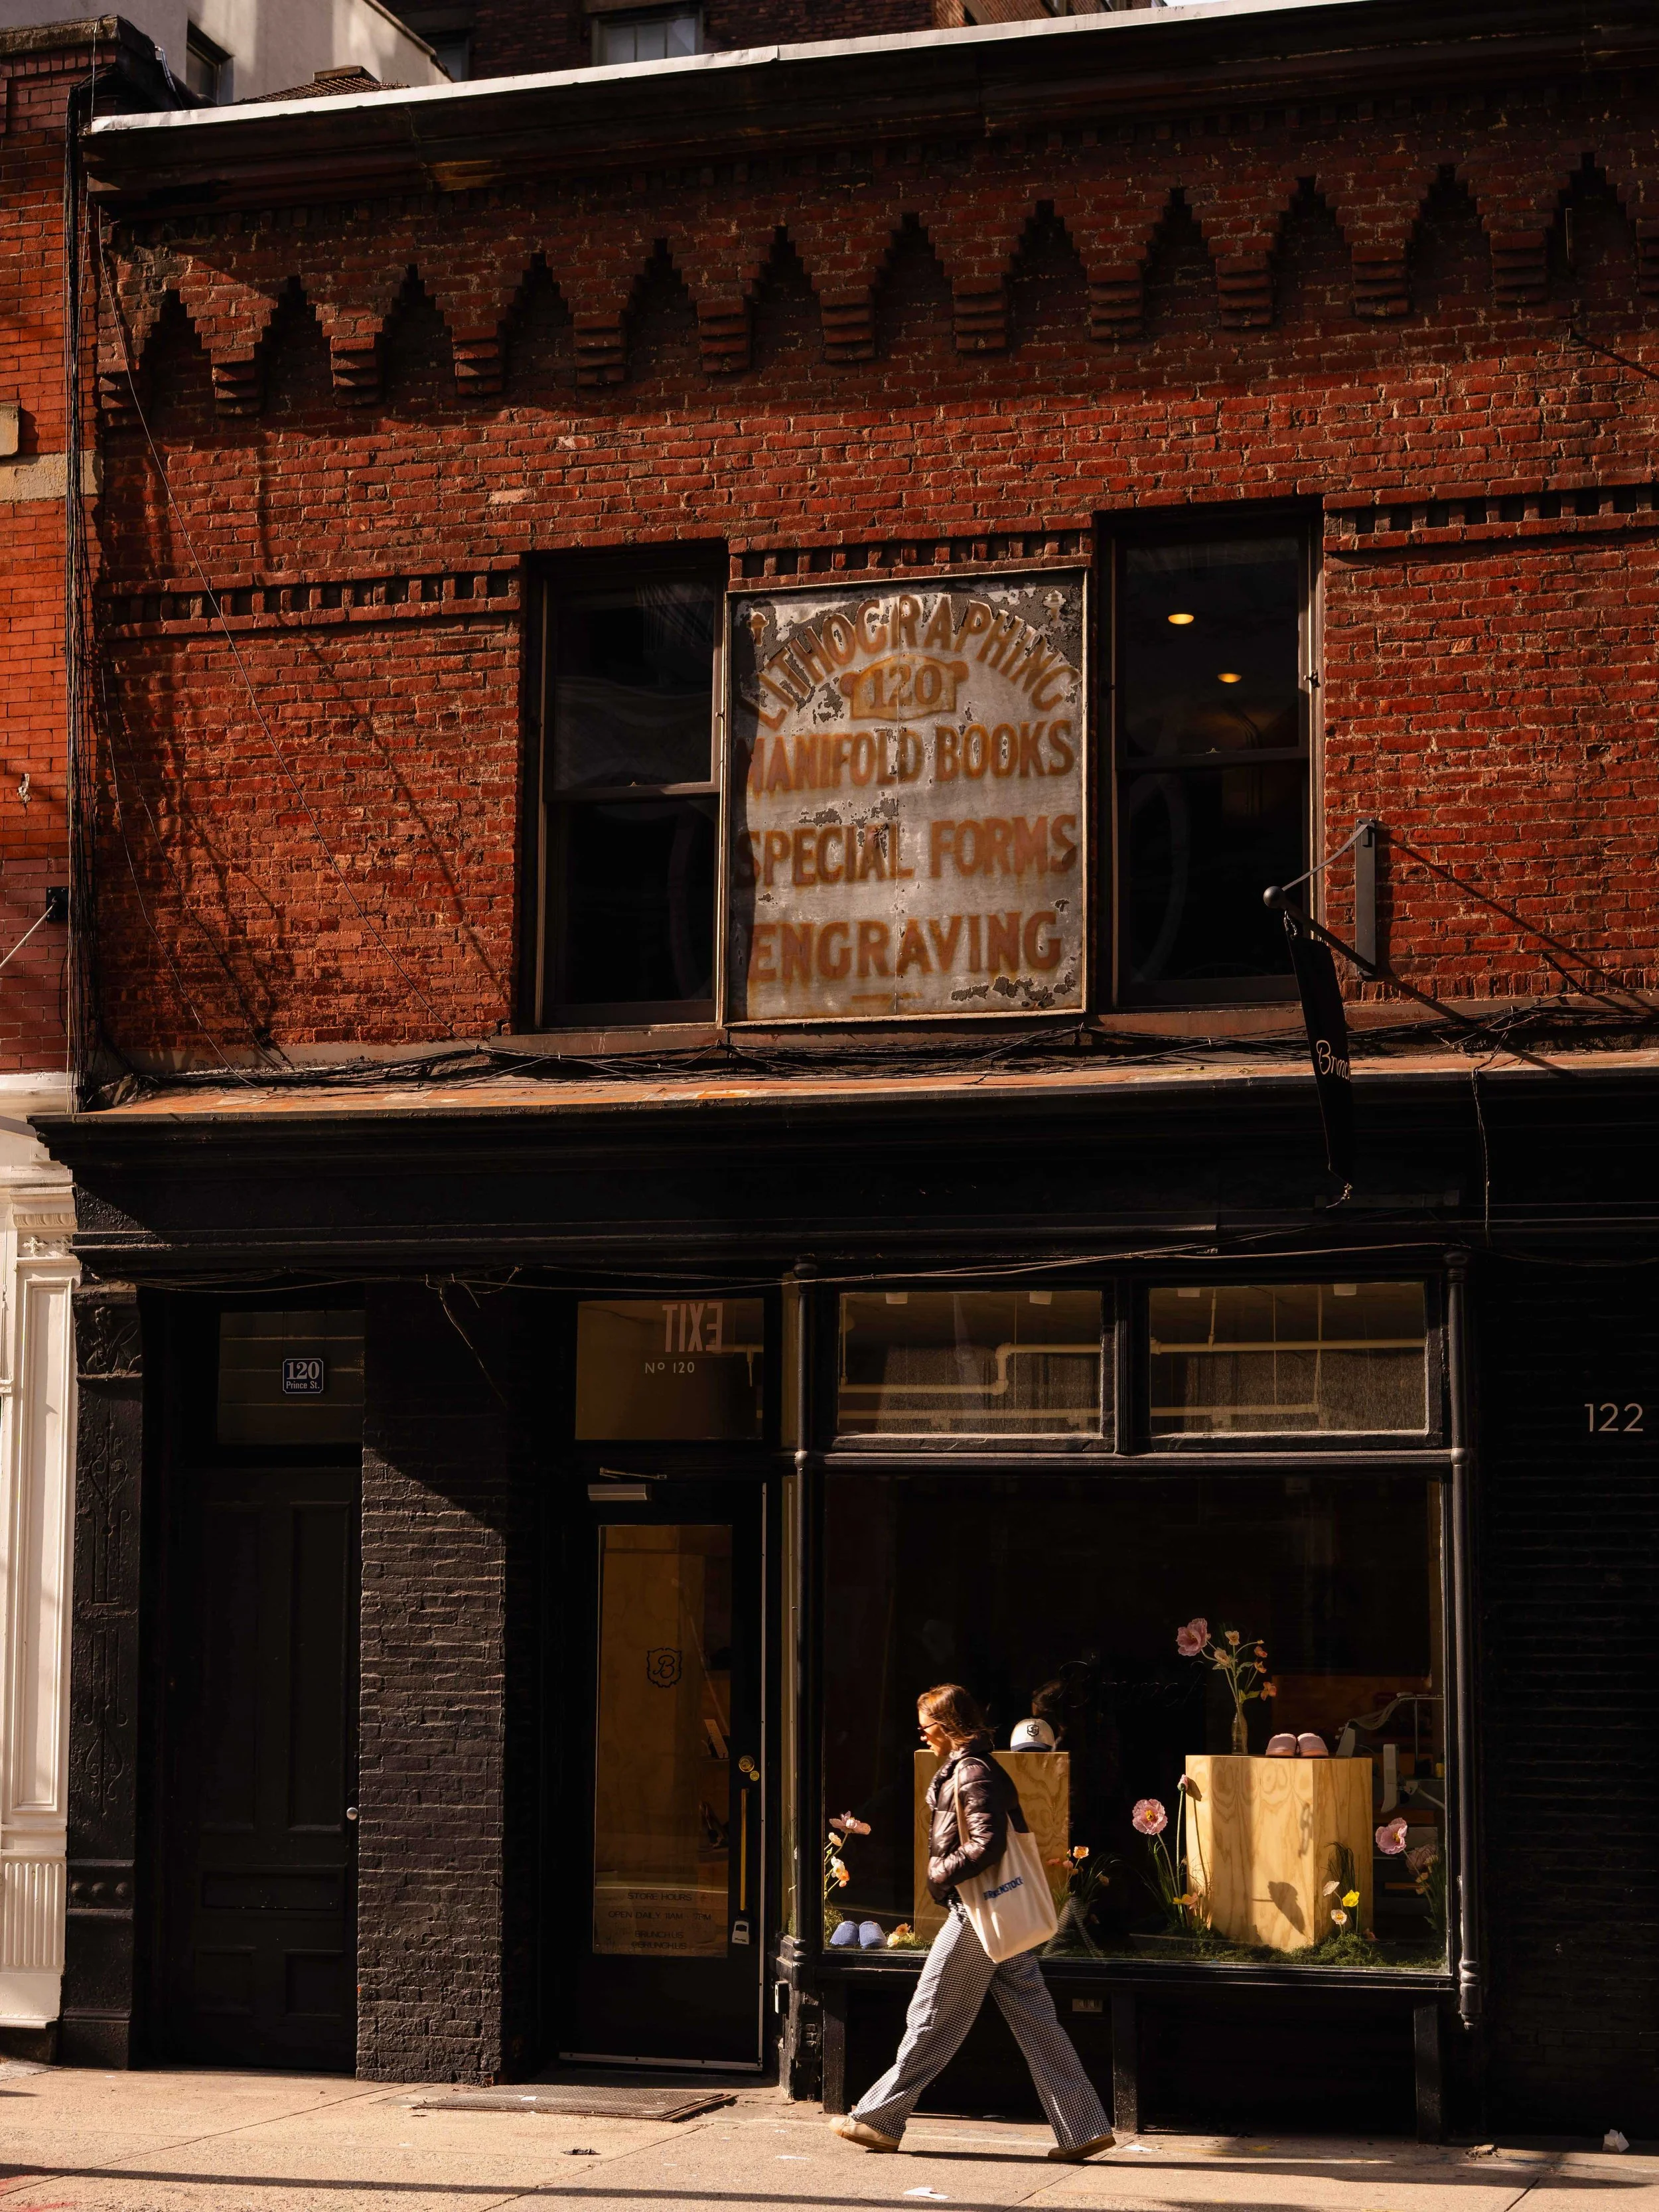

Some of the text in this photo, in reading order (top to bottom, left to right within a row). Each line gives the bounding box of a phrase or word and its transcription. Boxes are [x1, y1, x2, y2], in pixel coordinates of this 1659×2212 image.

[741, 594, 1081, 730] LITHOGRAPHING
[869, 665, 942, 710] 120
[735, 719, 1075, 791] MANIFOLD BOOKS
[735, 814, 1076, 887] SPECIAL FORMS
[748, 910, 1062, 982] ENGRAVING
[286, 1380, 320, 1389] Prince St.
[287, 1361, 320, 1380] 120
[673, 1361, 695, 1374] 120
[1584, 1402, 1644, 1432] 122
[661, 1893, 692, 1901] HOURS
